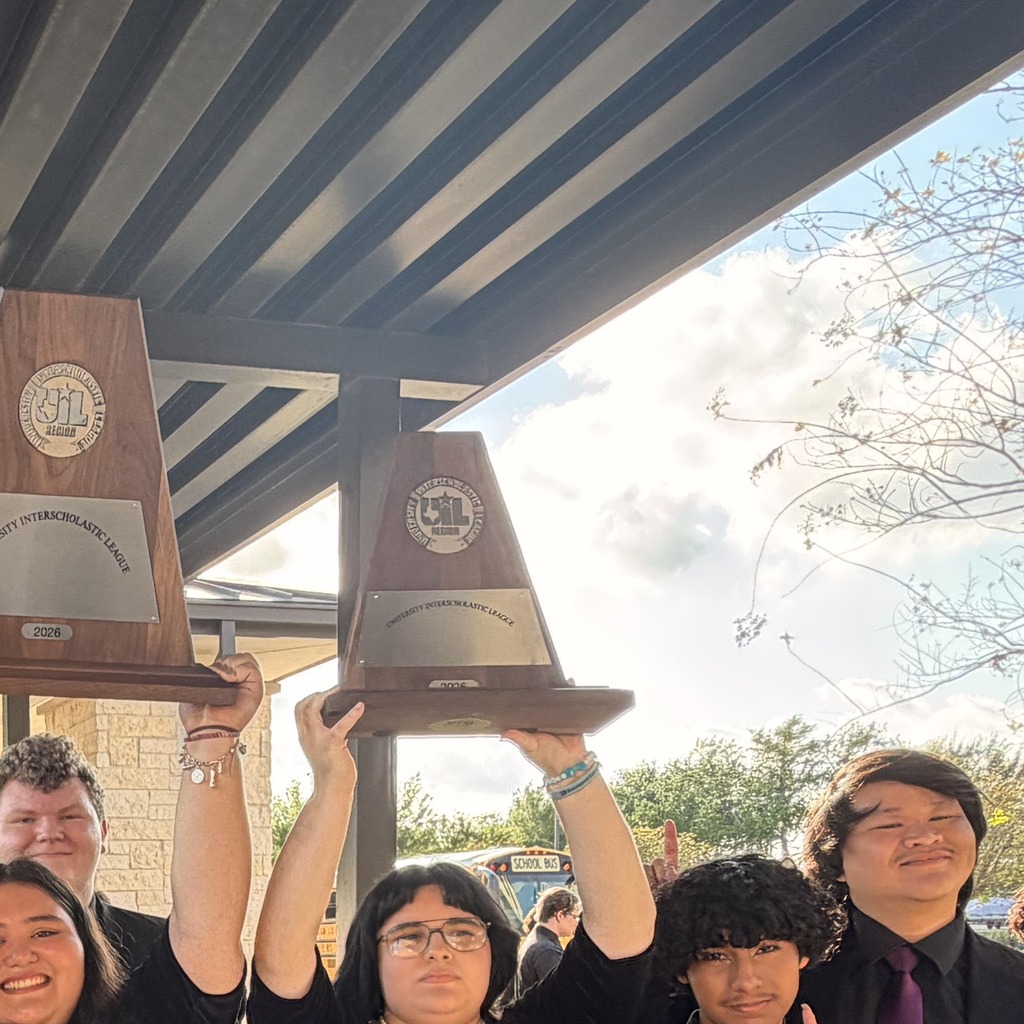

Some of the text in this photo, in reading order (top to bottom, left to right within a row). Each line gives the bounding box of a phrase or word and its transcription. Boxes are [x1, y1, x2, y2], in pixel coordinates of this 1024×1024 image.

[45, 424, 77, 437] REGION
[420, 491, 470, 526] UIL
[20, 510, 107, 542] INTERSCHOLASTIC
[103, 537, 131, 575] LEAGUE
[488, 607, 515, 627] LEAGUE
[33, 625, 61, 639] 2026
[513, 857, 558, 870] SCHOOL BUS
